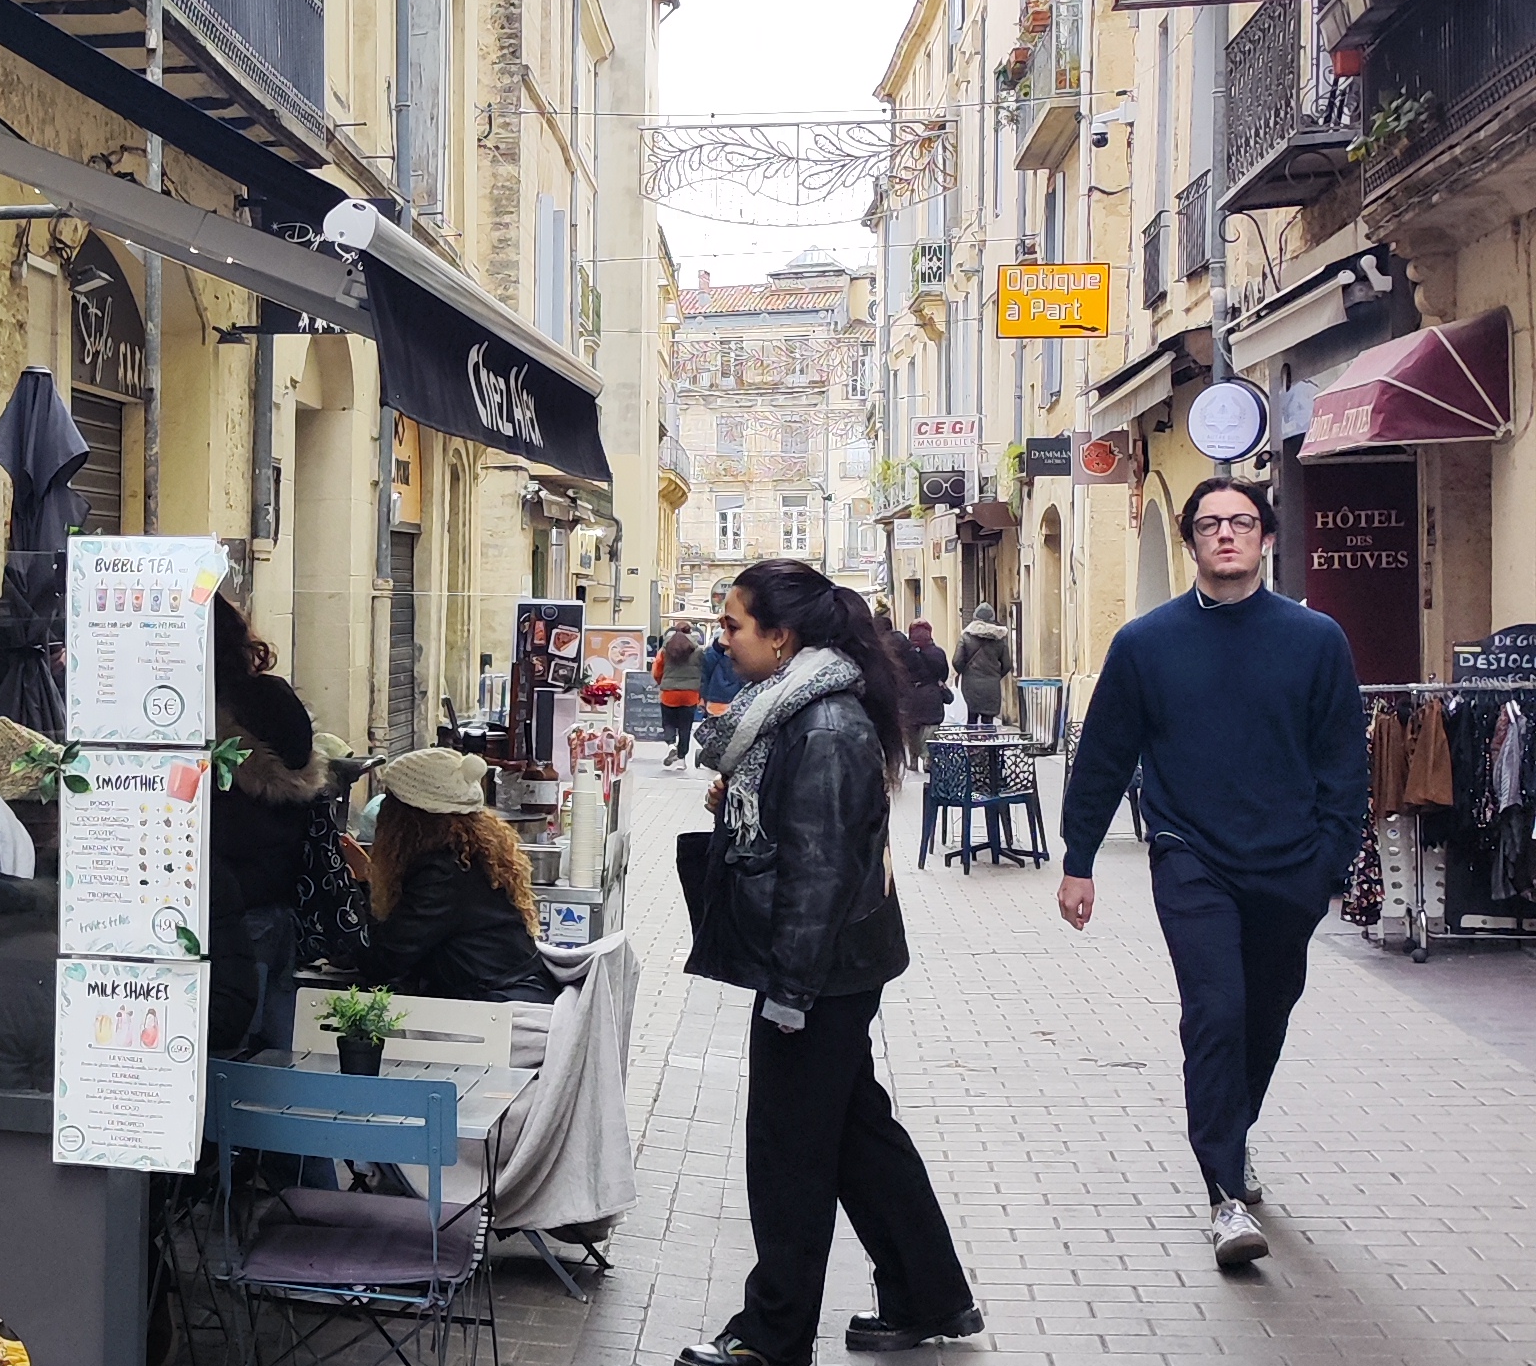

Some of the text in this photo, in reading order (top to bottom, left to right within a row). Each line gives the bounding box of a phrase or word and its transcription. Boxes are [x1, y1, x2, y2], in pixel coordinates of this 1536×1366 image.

[1006, 268, 1101, 293] Optique
[1006, 298, 1082, 321] à Part
[467, 340, 545, 450] Chez Alex
[917, 420, 976, 436] CEGI
[1315, 505, 1405, 529] HÔTEL
[1346, 535, 1373, 547] DES
[94, 557, 174, 574] BUBBLE TEA
[1311, 547, 1409, 571] ÉTUVES
[1459, 653, 1536, 670] DESTOC
[151, 698, 177, 716] 5€
[95, 773, 166, 792] SMOOTHIES
[87, 980, 169, 1002] MILK SHAKES
